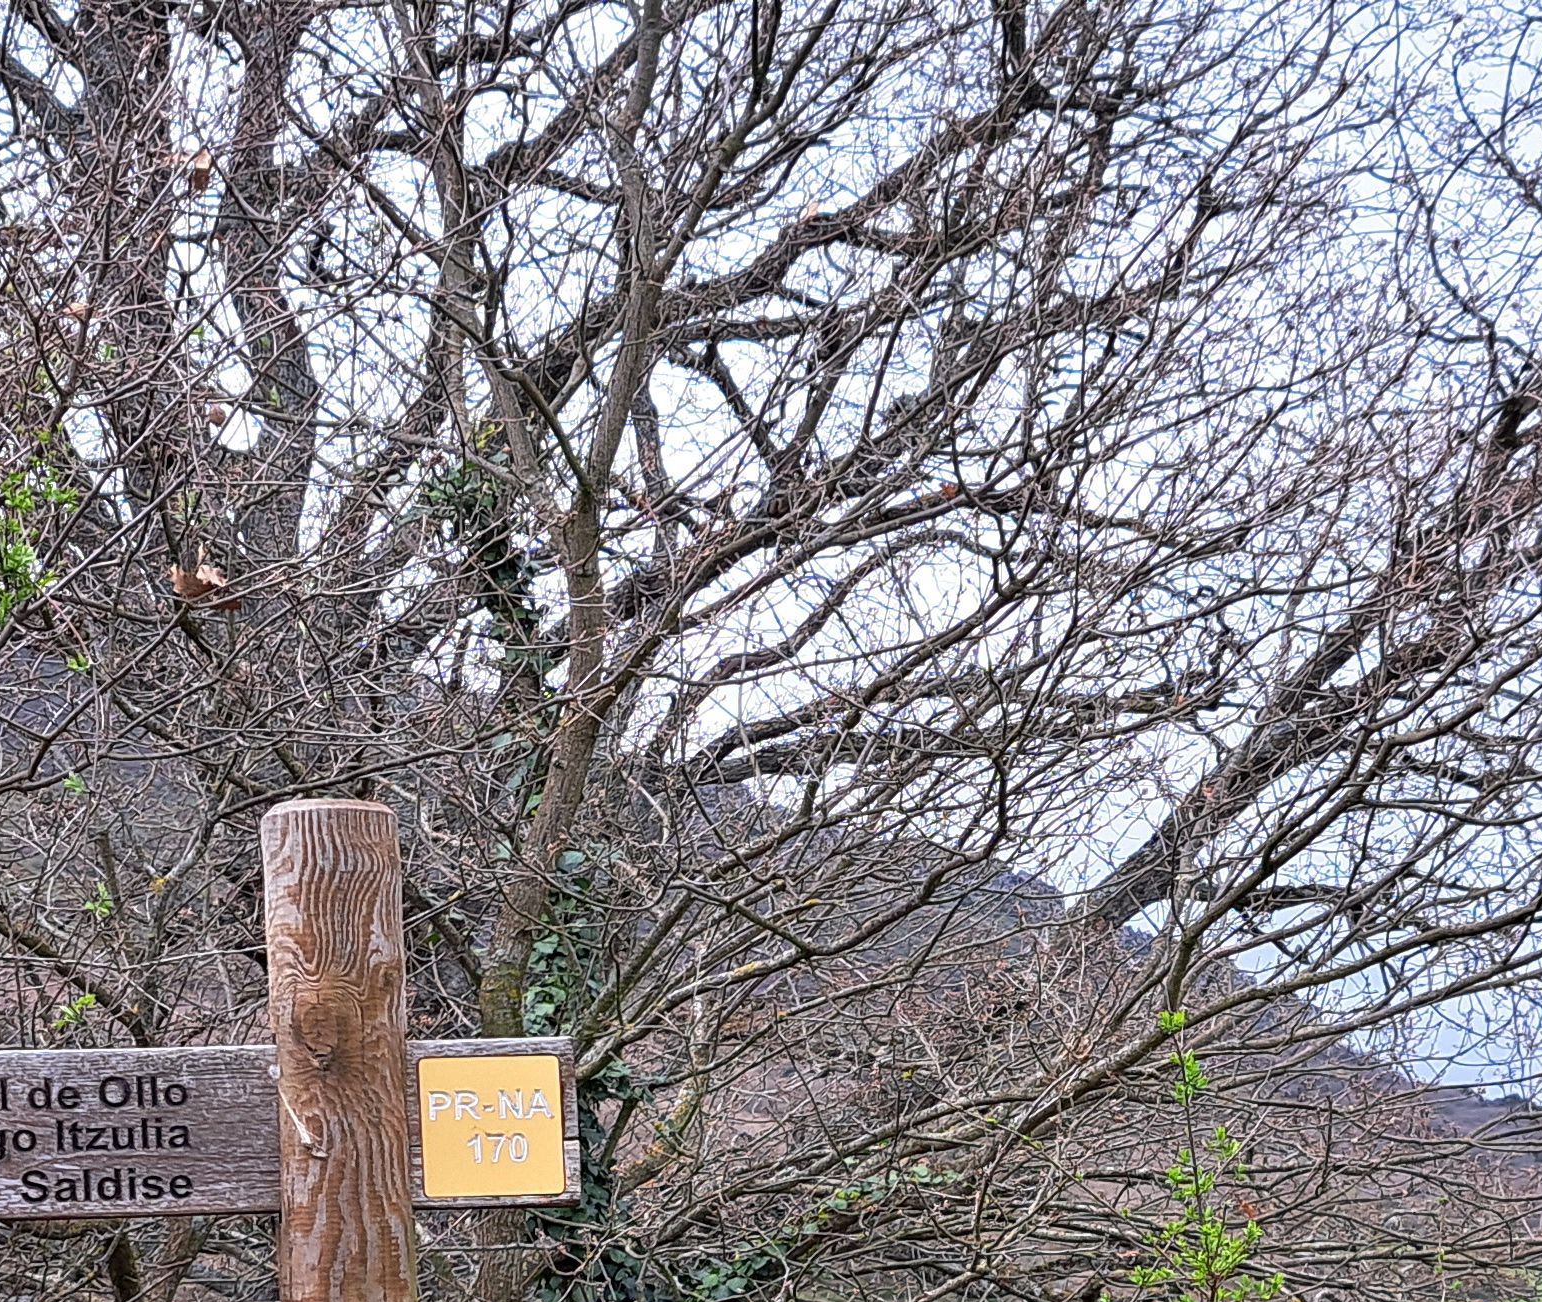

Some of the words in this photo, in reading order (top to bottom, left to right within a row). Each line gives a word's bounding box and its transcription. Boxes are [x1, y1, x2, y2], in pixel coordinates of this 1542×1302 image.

[28, 1077, 83, 1111] de
[98, 1074, 188, 1109] Ollo
[428, 1087, 554, 1122] PR-NA
[57, 1117, 191, 1153] Itzulia
[467, 1132, 530, 1165] 170
[21, 1167, 194, 1204] Saldise
